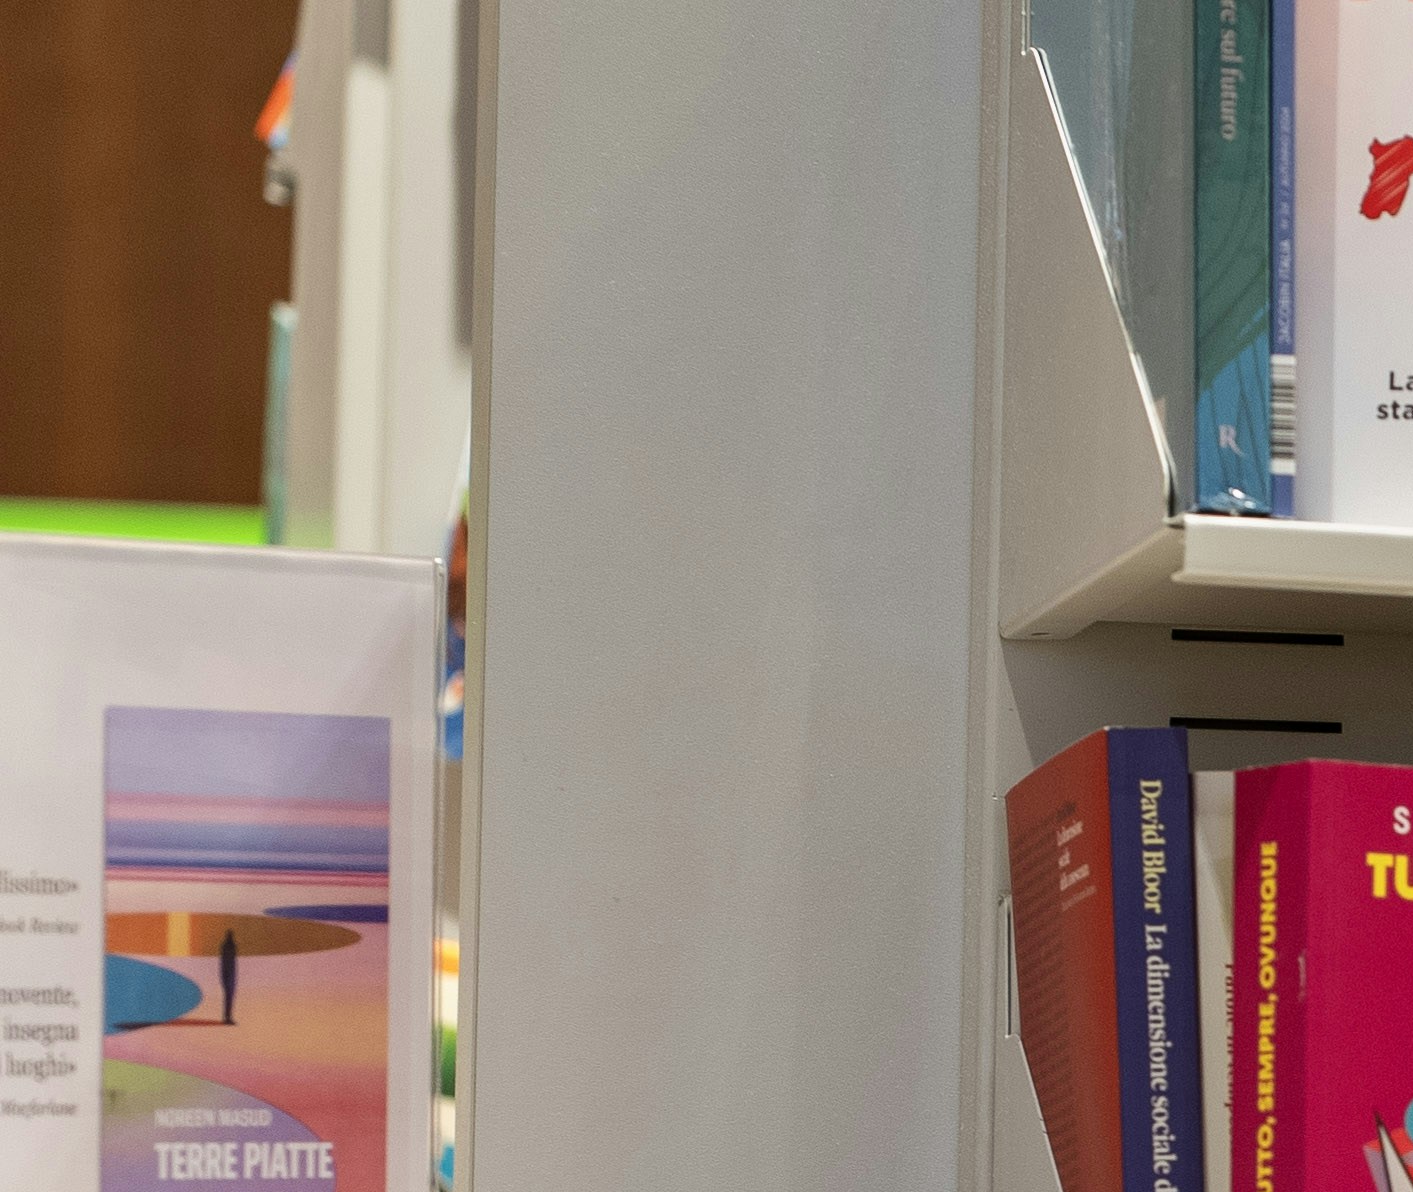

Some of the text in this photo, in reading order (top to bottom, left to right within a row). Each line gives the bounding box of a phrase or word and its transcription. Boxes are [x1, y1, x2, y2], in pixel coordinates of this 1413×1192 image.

[1140, 780, 1167, 845] David
[1141, 850, 1168, 914] Bloor
[1144, 923, 1168, 951] La
[1146, 955, 1173, 1090] dimensione
[153, 1139, 336, 1181] TERRE PIATTE
[1150, 1095, 1178, 1175] sociale
